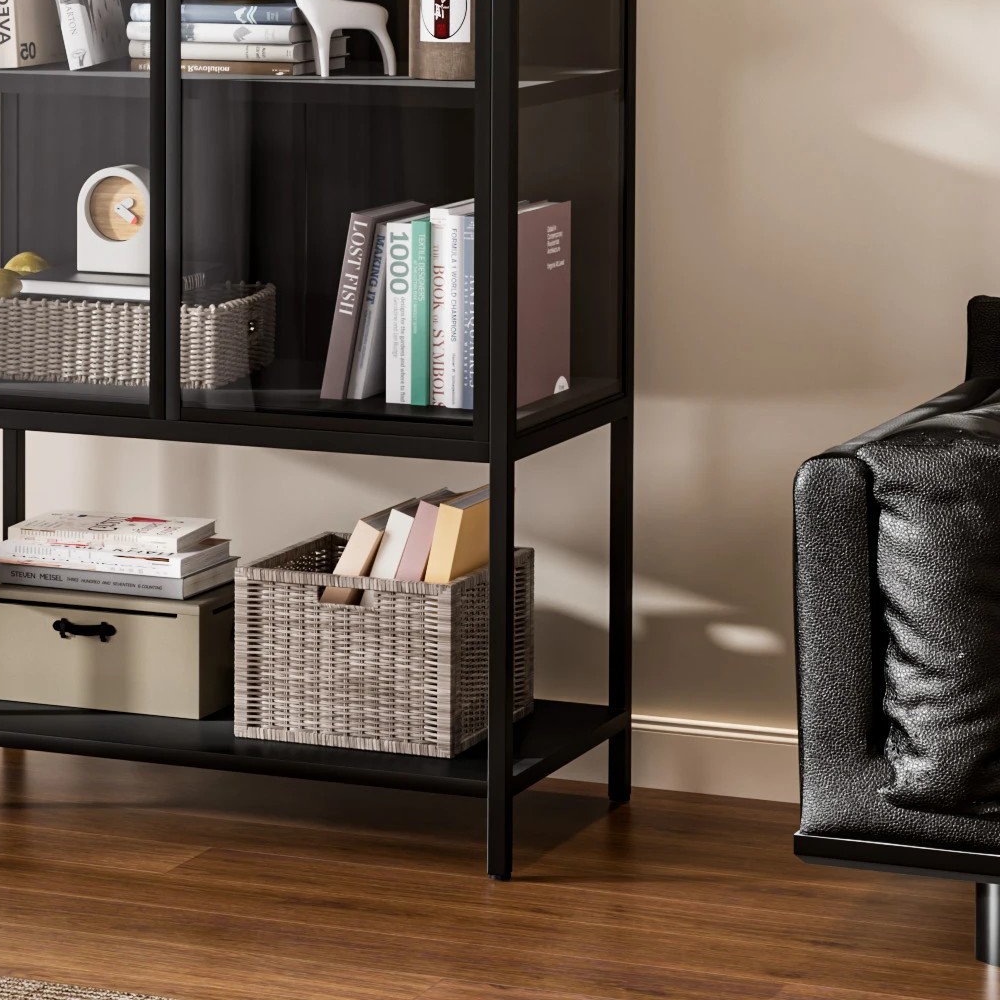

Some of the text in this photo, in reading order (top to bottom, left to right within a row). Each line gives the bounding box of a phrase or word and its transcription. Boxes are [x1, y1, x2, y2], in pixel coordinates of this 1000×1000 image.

[339, 220, 368, 317] LOST FISH
[366, 234, 386, 305] MAKING IT
[390, 232, 410, 295] 1000
[418, 233, 426, 302] TEXTILE DESIGNERS
[450, 228, 458, 264] FORMULA
[432, 264, 445, 310] BOOK
[450, 270, 458, 298] WORLD
[450, 299, 458, 342] CHAMPIONS
[432, 328, 446, 407] SYMBOLS
[10, 570, 36, 580] STEVEN
[40, 574, 63, 582] MEISEL
